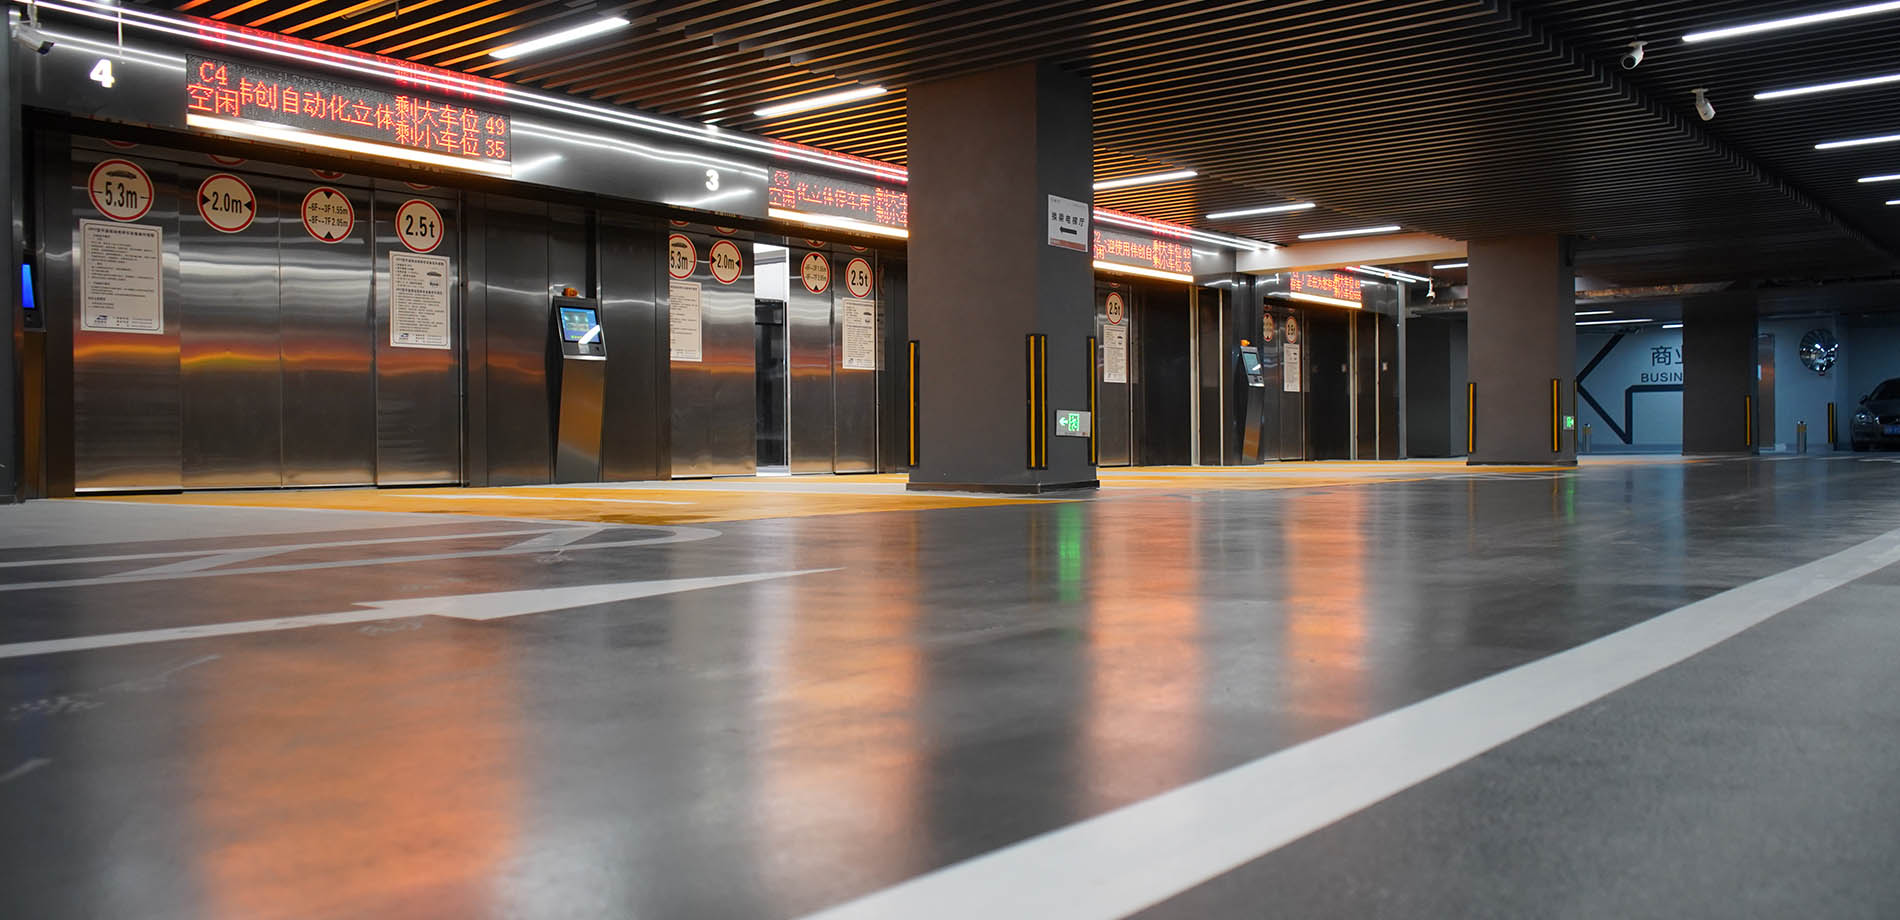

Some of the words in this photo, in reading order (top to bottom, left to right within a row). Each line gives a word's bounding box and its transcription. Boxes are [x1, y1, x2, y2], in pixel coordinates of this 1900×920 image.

[90, 59, 115, 88] 4
[199, 61, 229, 86] C4
[187, 82, 240, 117] 空闲
[395, 95, 480, 134] 剩大车位
[485, 116, 506, 136] 49
[395, 119, 480, 157] 剩小车位
[485, 139, 506, 159] 35
[705, 169, 720, 192] 3
[105, 182, 138, 209] 5.3m
[212, 191, 242, 214] 2.0m
[405, 214, 435, 238] 2.5t
[670, 250, 688, 270] 5.3m
[717, 253, 735, 271] 2.0m
[851, 270, 868, 287] 2.5t
[1109, 302, 1121, 316] 2.5t
[1641, 372, 1683, 383] BUSIN
